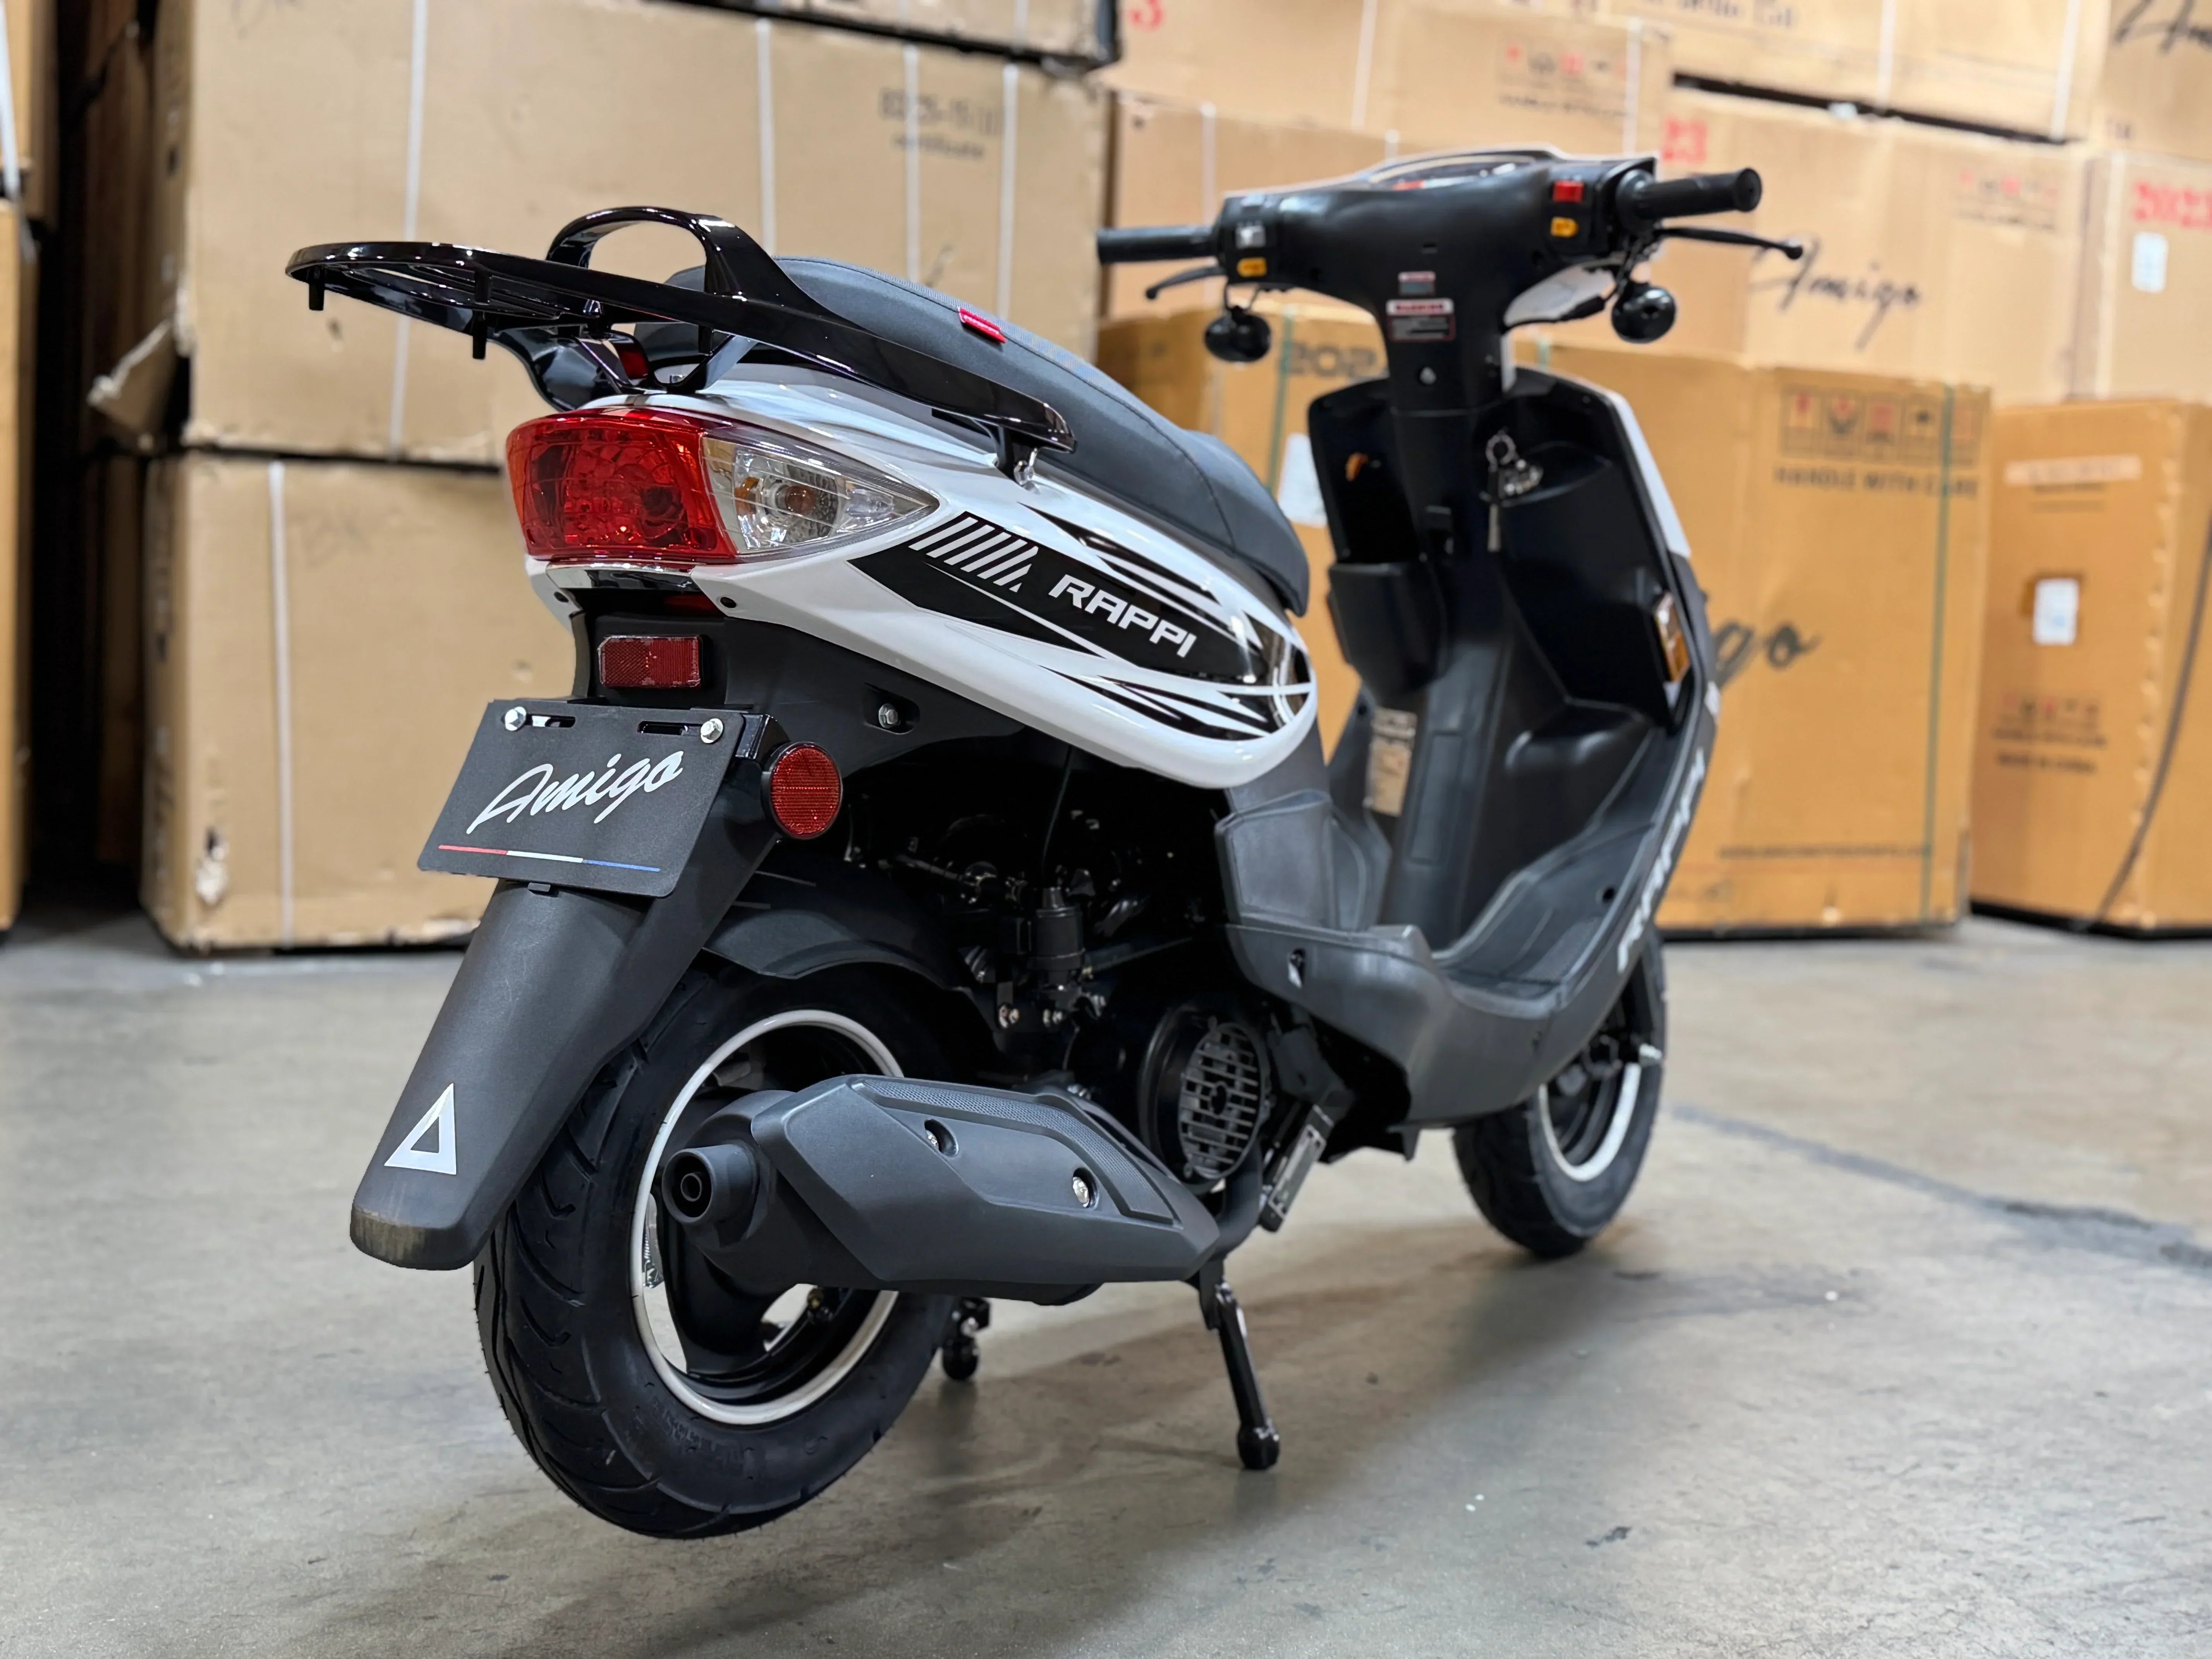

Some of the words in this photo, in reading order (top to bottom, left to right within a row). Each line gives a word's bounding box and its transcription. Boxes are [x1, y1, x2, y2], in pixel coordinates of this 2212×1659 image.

[1925, 475, 1977, 499] CRE
[1048, 574, 1197, 658] RAPPI
[466, 750, 684, 835] Amigo
